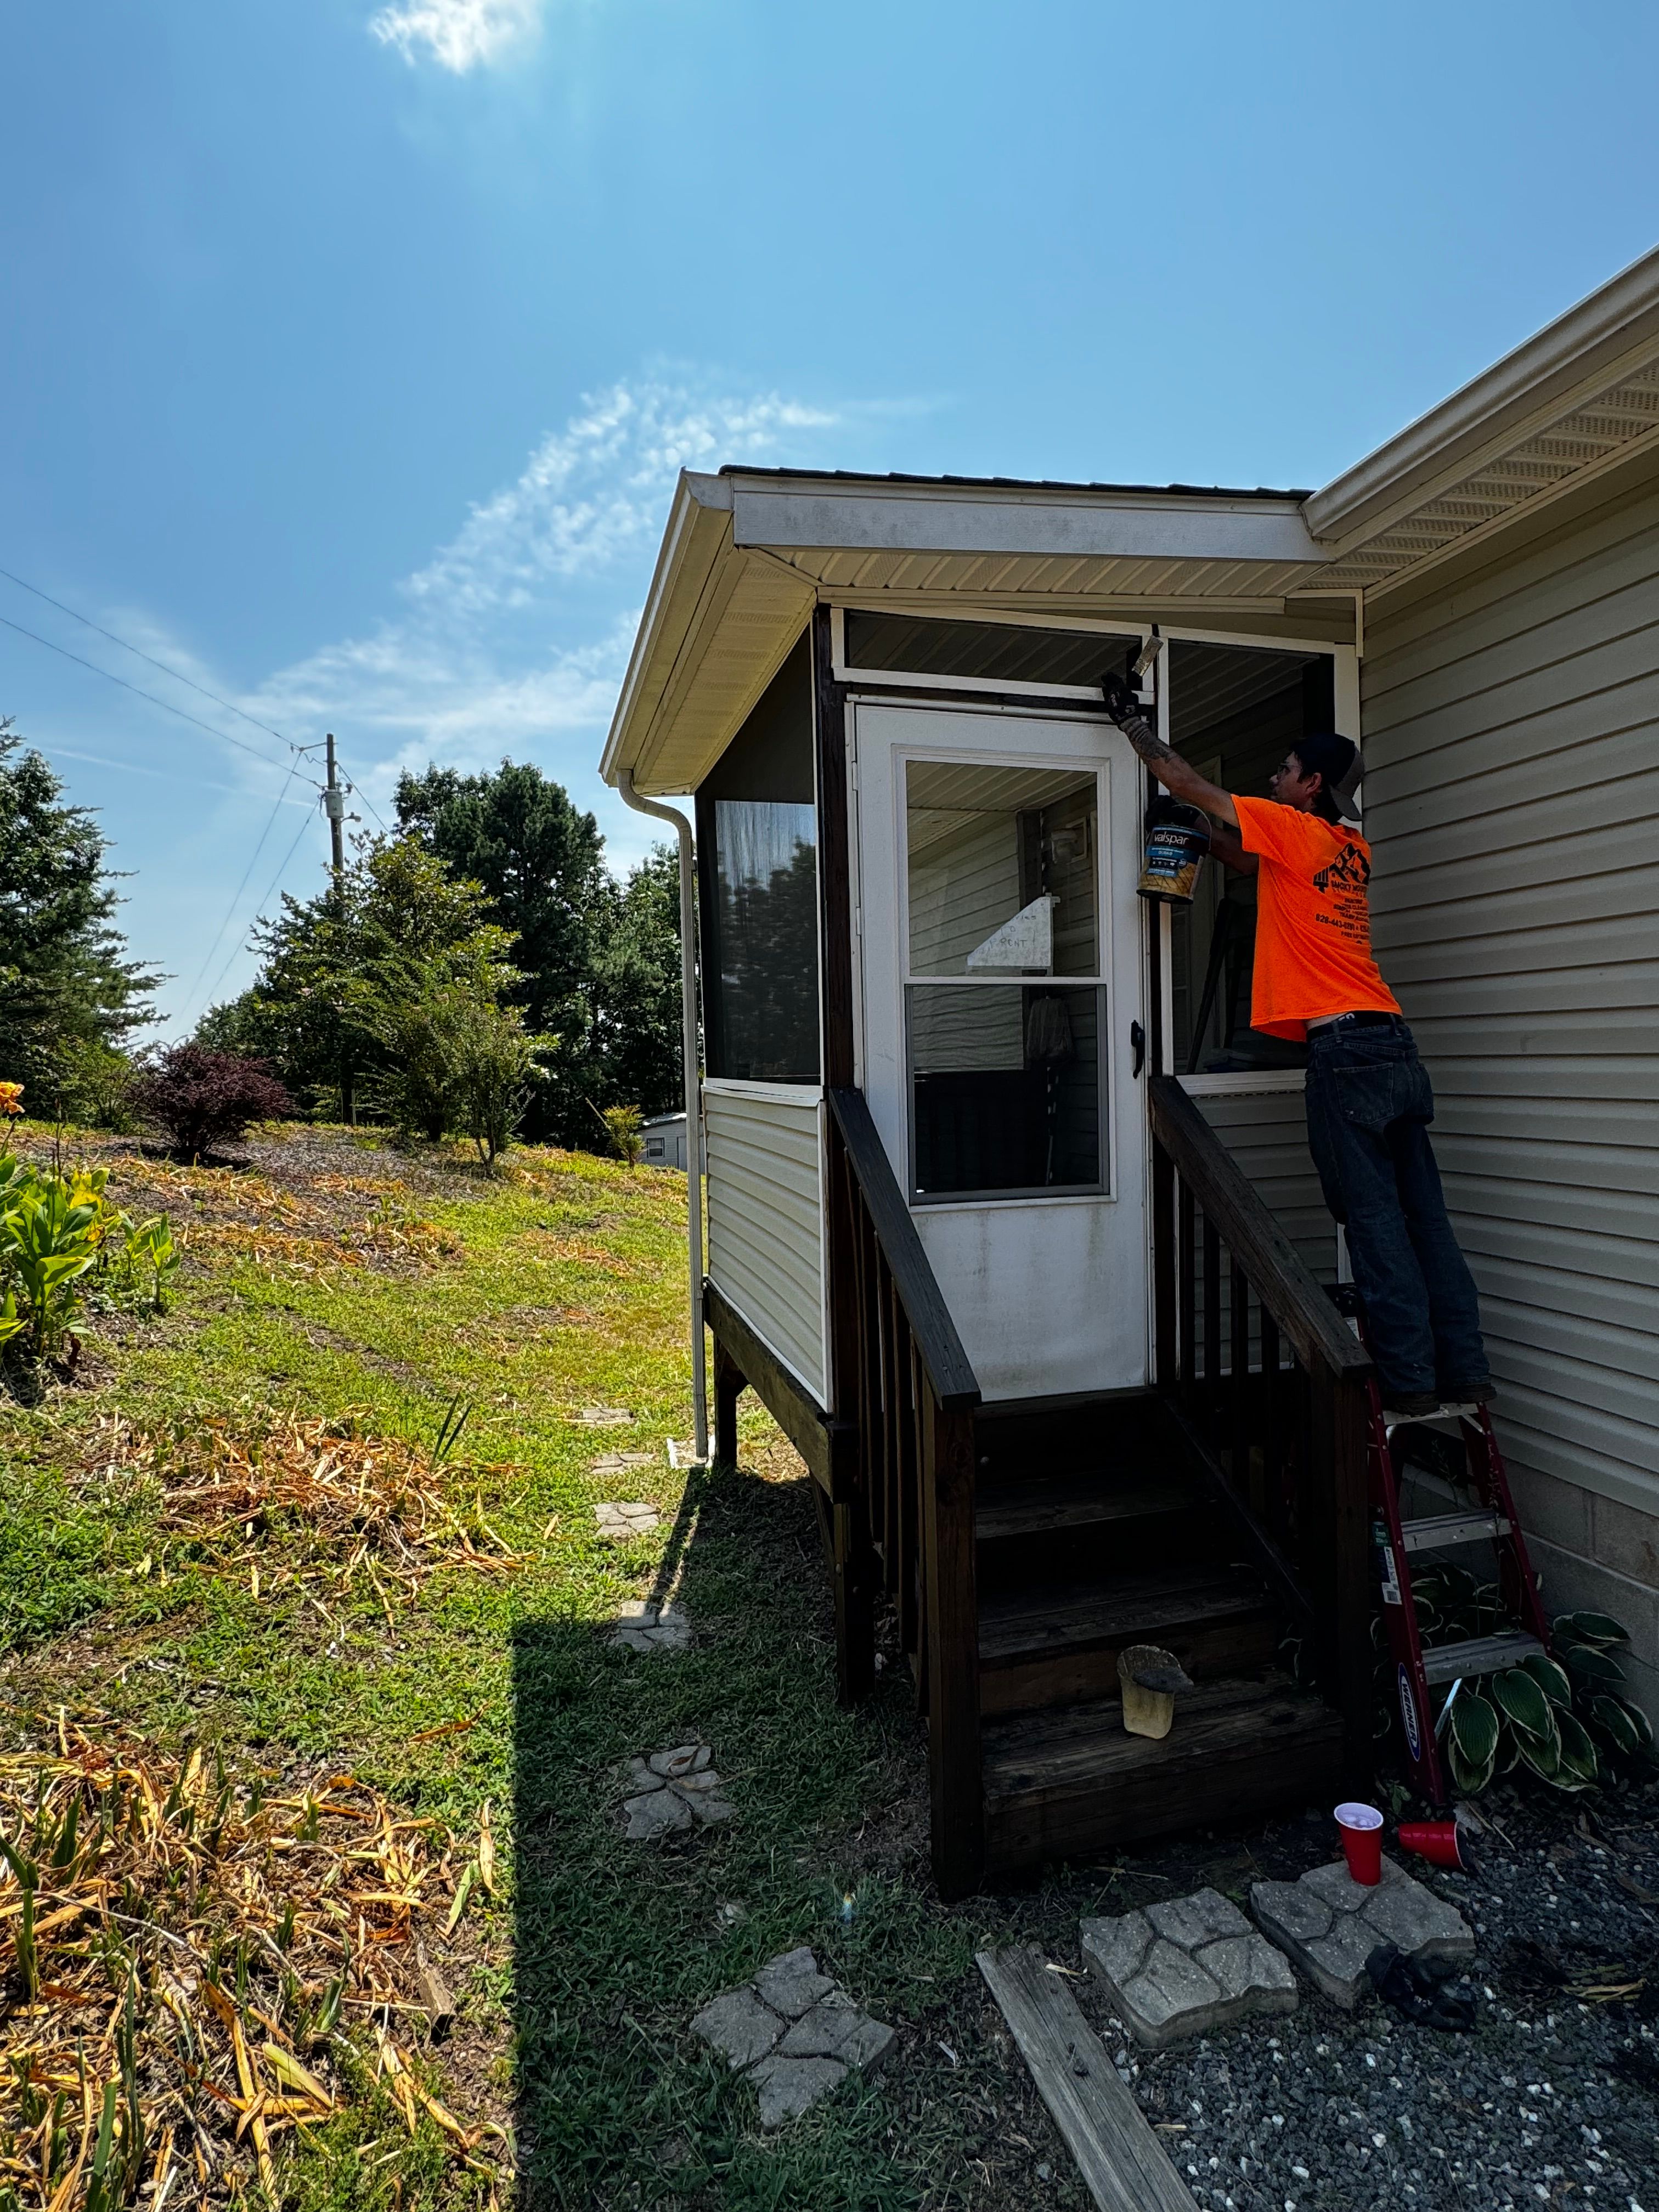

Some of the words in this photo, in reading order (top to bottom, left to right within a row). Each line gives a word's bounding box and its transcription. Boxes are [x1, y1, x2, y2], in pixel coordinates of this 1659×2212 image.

[1154, 832, 1189, 845] valspar
[989, 936, 1028, 949] FRONT
[1402, 1683, 1417, 1742] WERNER
